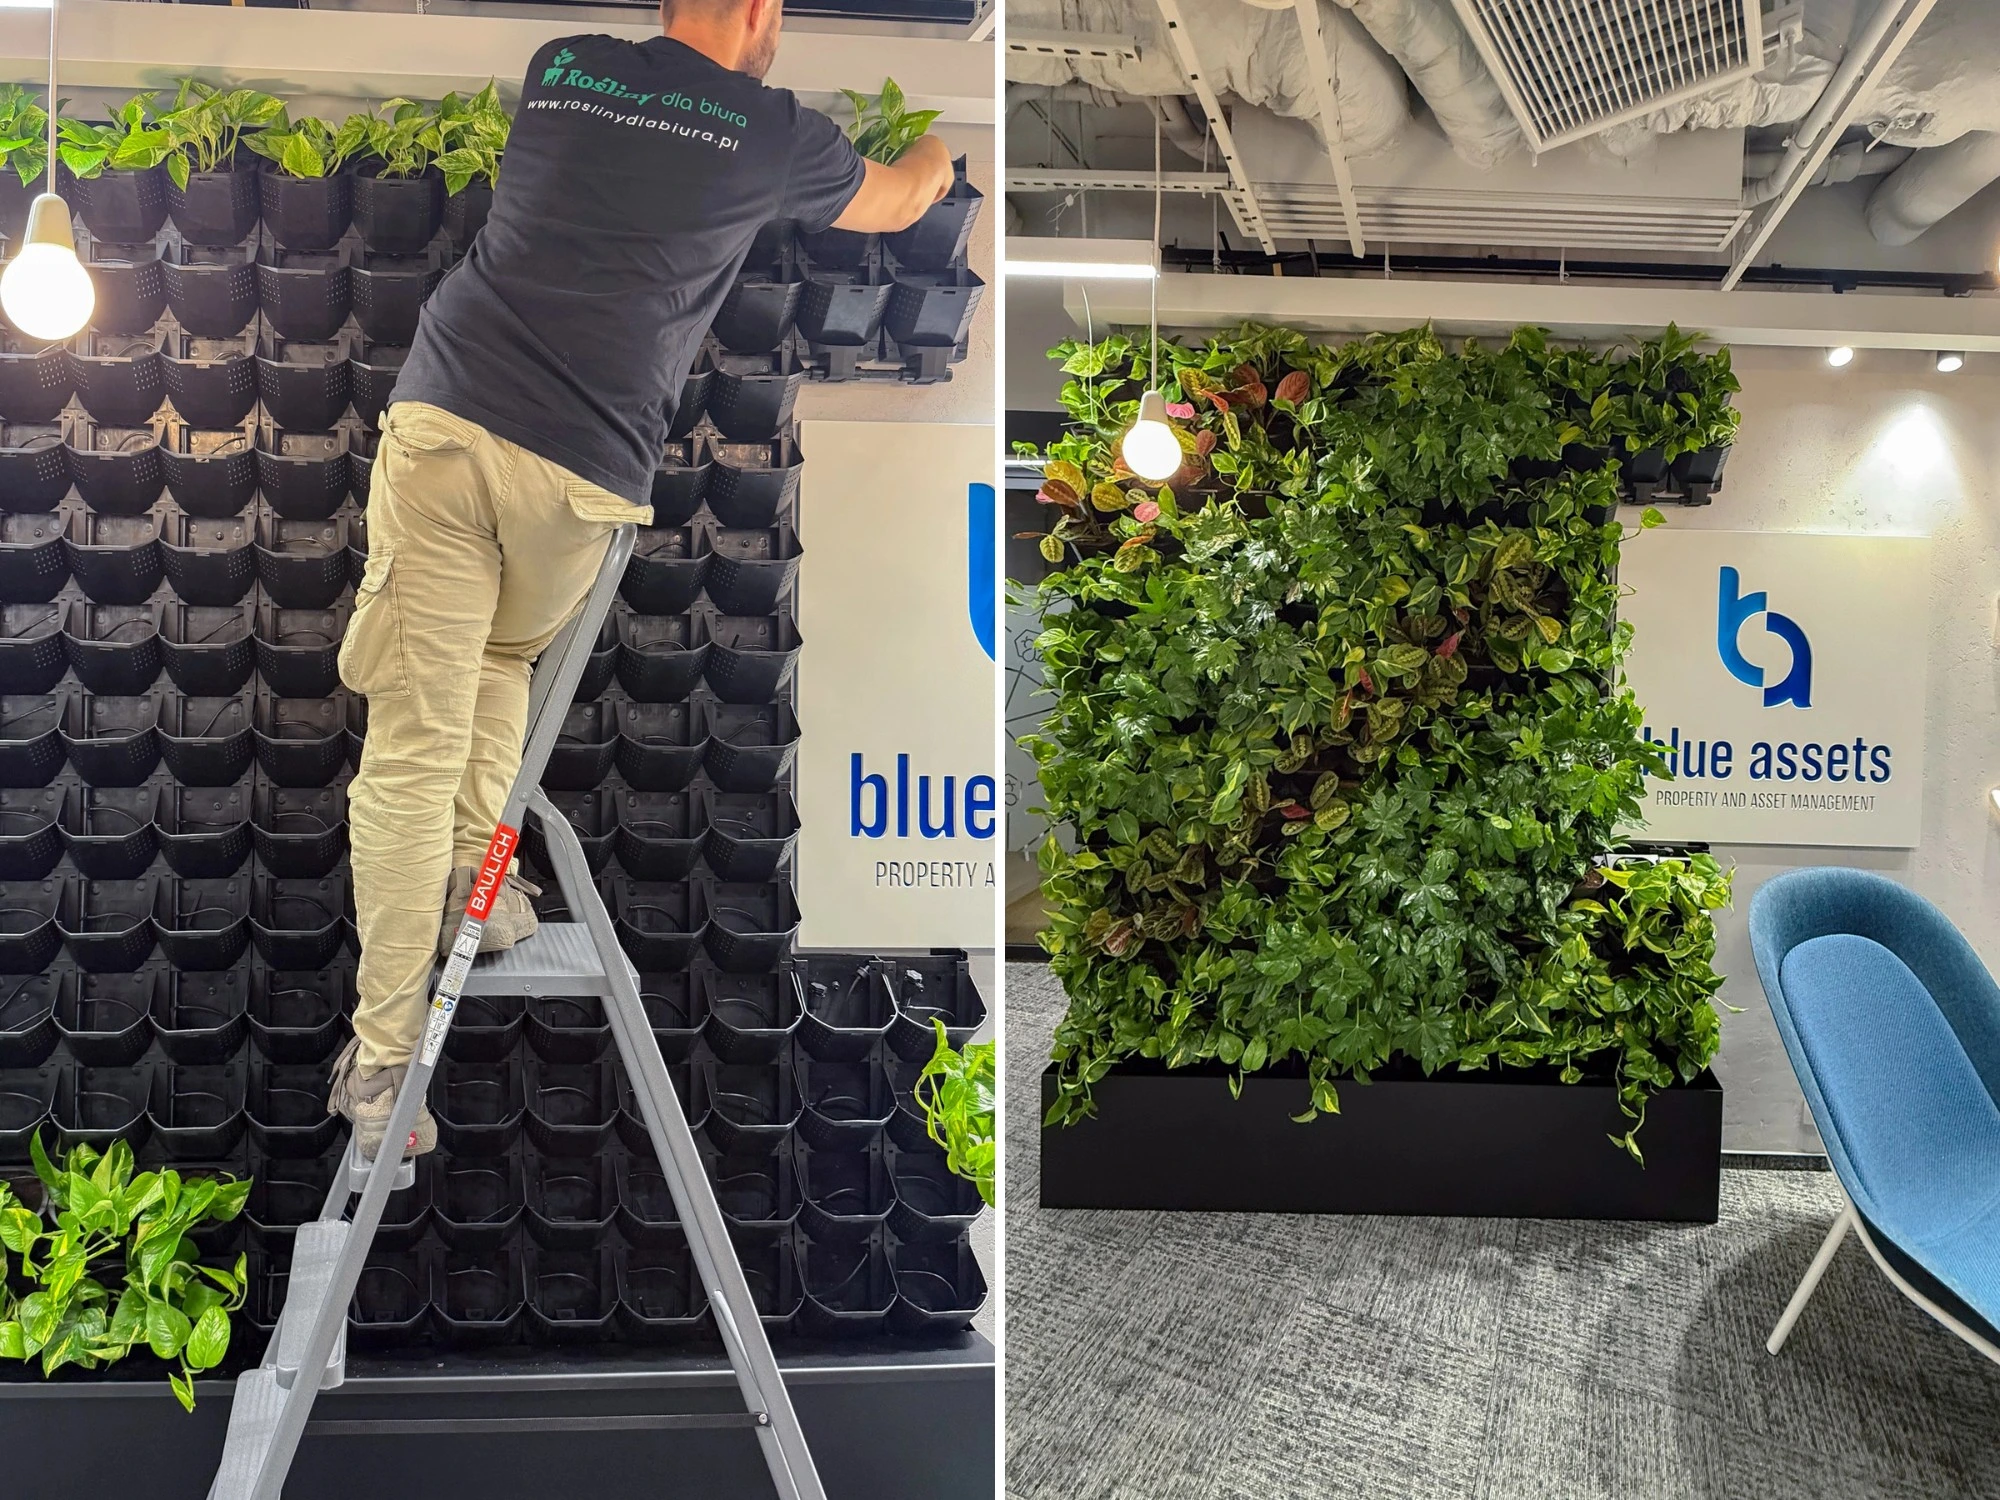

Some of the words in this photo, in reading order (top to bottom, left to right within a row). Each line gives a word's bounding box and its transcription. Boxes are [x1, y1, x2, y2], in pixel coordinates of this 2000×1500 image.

[527, 98, 739, 152] www.roslinydlabiura.pl
[562, 68, 656, 106] Rośliny
[661, 92, 692, 111] dla
[699, 98, 748, 128] biura
[1749, 736, 1891, 783] assets
[850, 752, 995, 838] blue
[1656, 790, 1718, 807] PROPERTY
[1721, 792, 1746, 808] AND
[1750, 793, 1787, 809] ASSET
[1791, 794, 1876, 811] MANAGEMENT
[471, 832, 513, 912] BAULICH
[875, 861, 978, 887] PROPERTY
